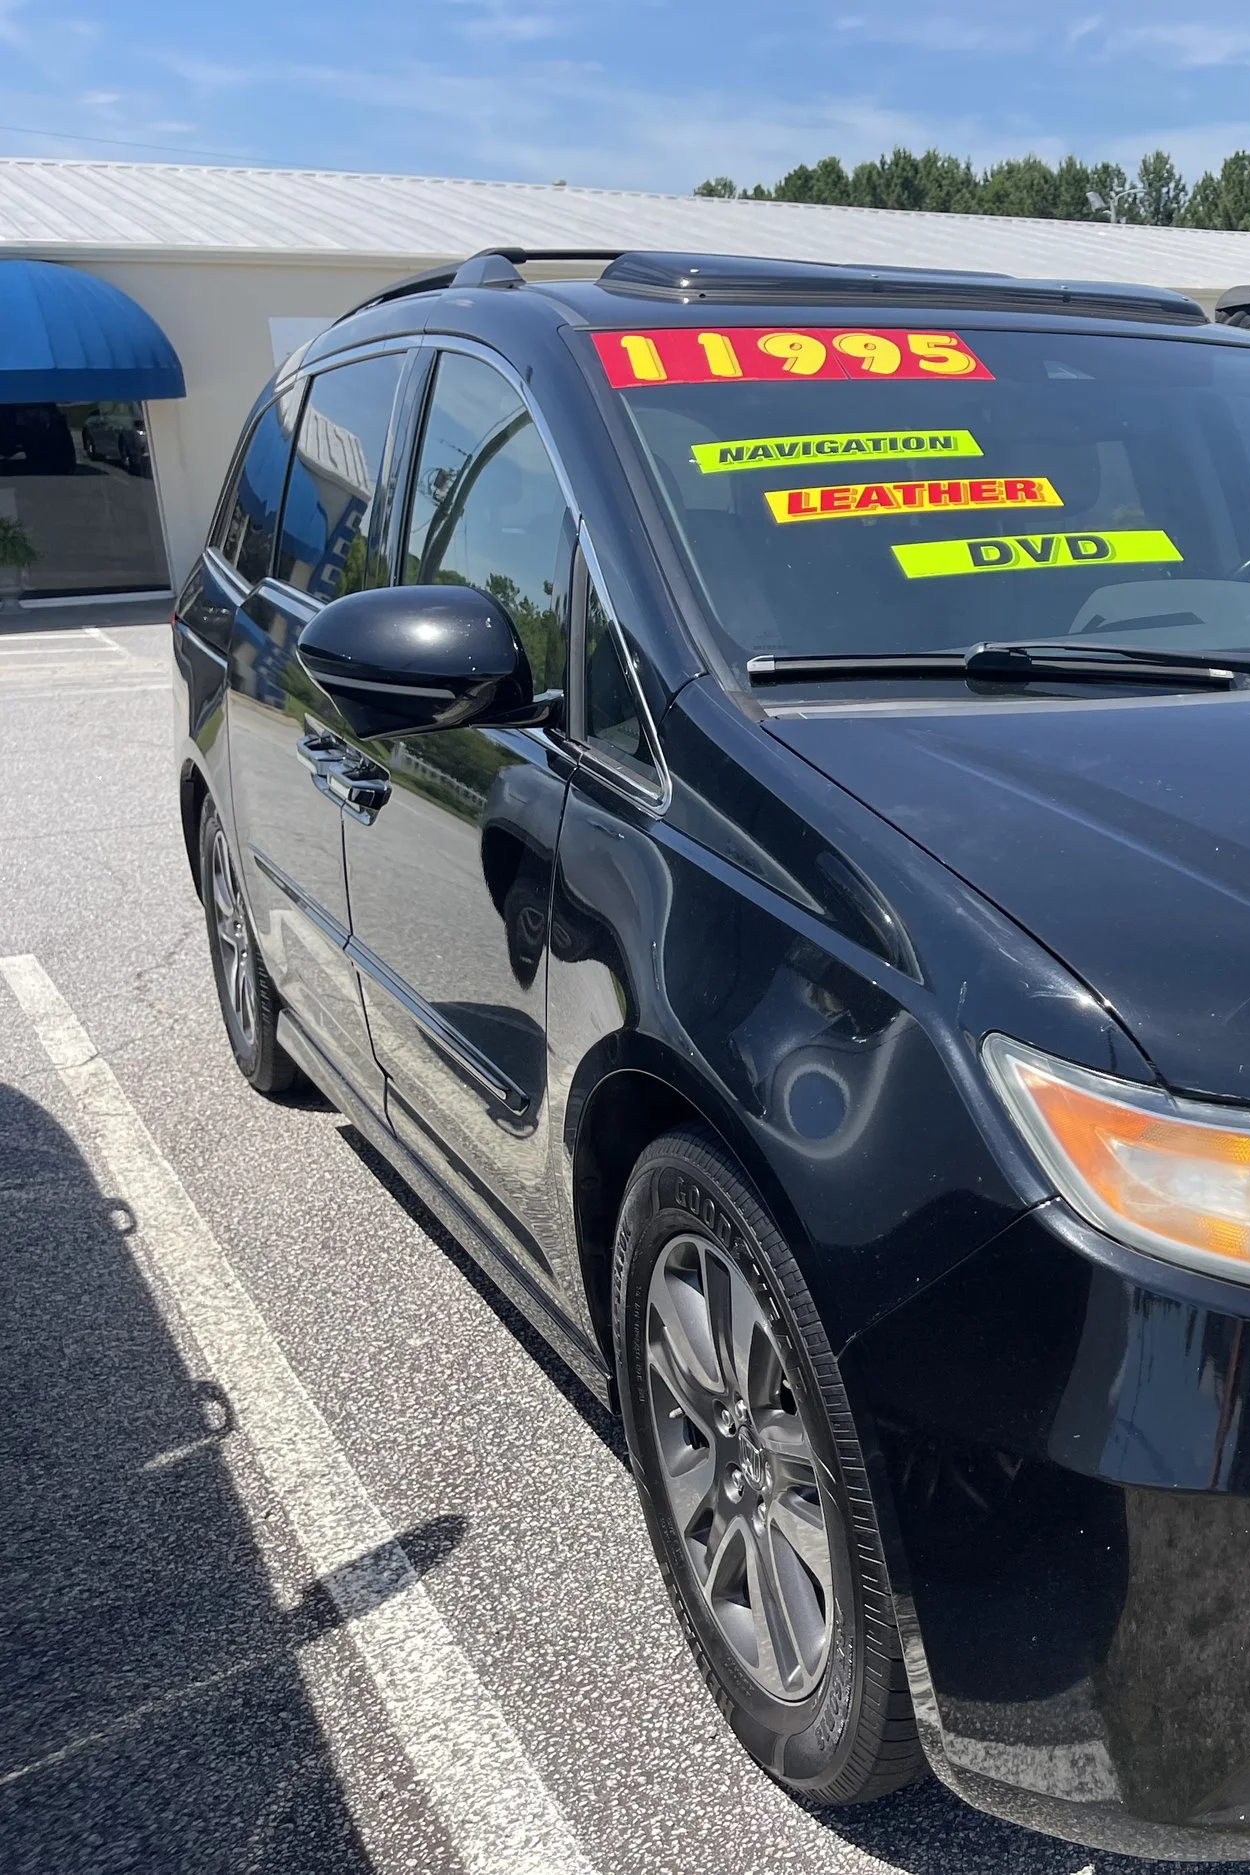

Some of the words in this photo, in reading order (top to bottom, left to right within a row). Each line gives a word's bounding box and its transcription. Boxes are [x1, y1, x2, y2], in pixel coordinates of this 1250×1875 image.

[620, 332, 976, 381] 11995
[718, 435, 957, 464] NAVIGATION
[787, 479, 1043, 518] LEATHER
[966, 535, 1114, 568] DVD
